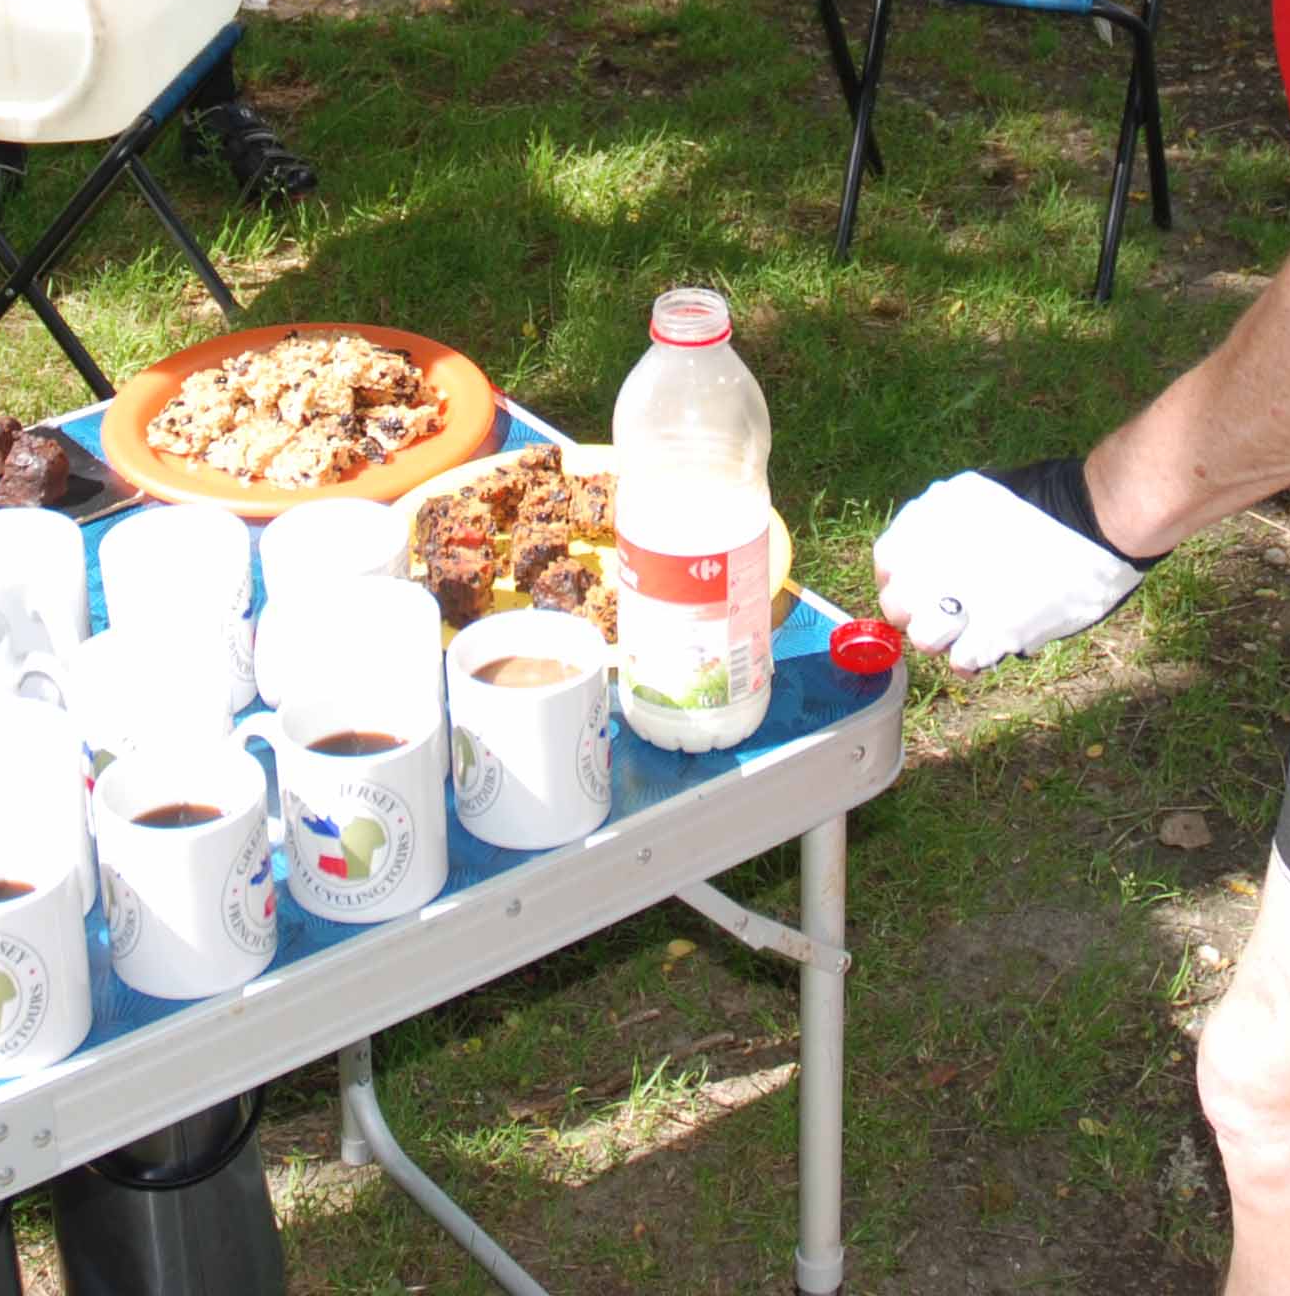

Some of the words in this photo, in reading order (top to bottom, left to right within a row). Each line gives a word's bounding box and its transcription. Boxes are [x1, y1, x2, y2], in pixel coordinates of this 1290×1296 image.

[314, 884, 388, 905] CYCLING
[385, 831, 411, 884] TOURS
[16, 982, 44, 1039] TOURS
